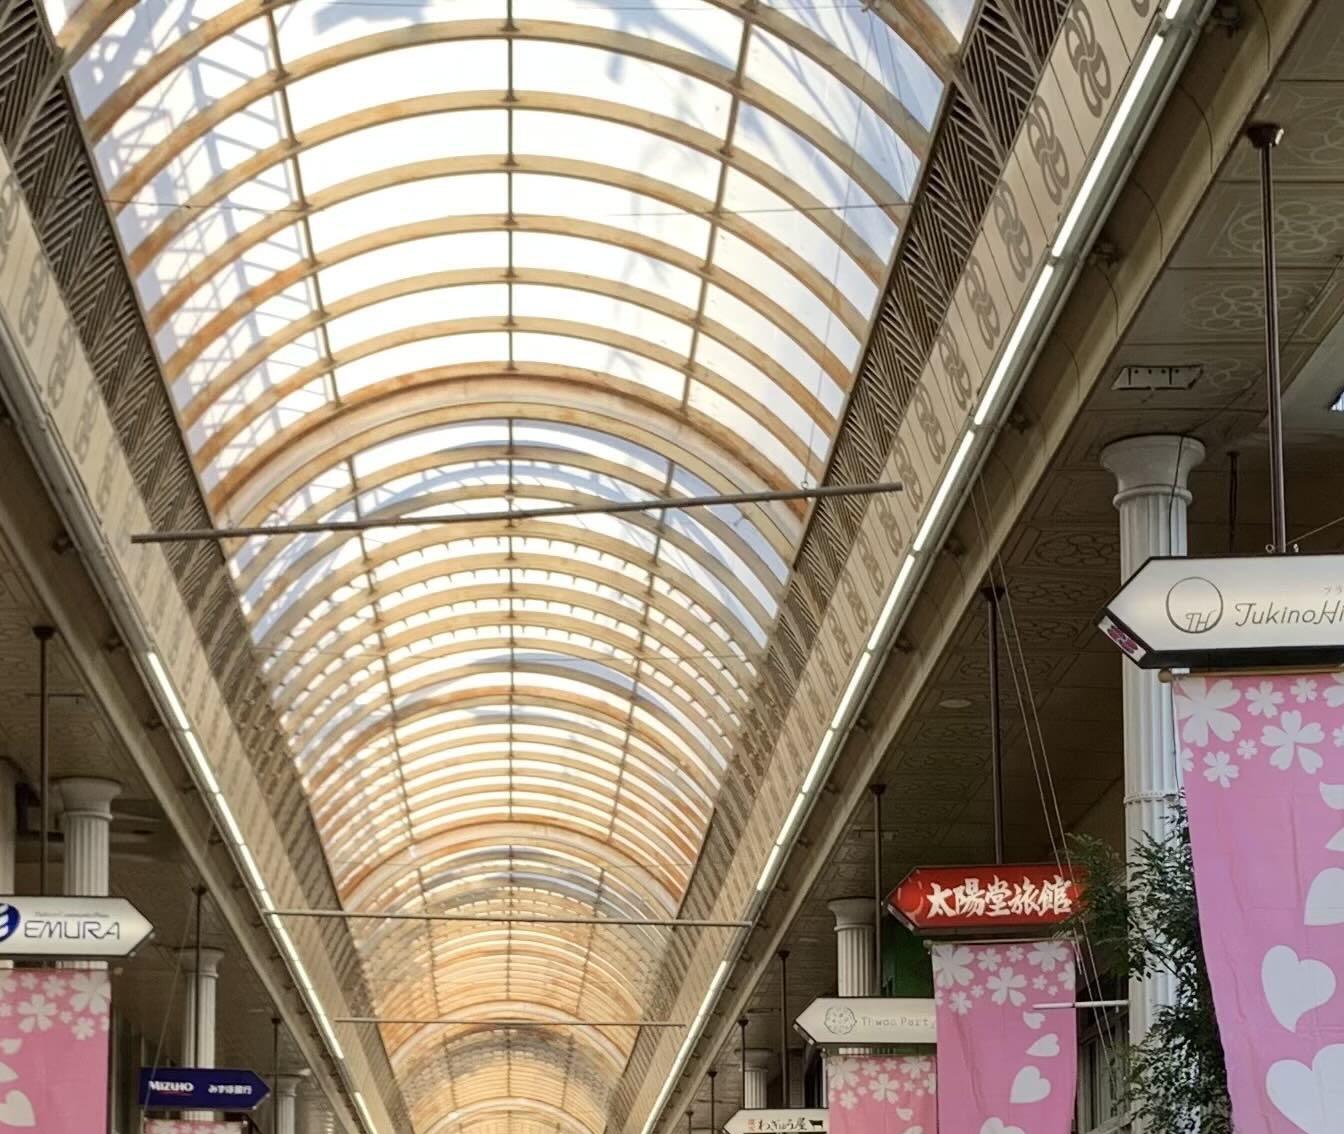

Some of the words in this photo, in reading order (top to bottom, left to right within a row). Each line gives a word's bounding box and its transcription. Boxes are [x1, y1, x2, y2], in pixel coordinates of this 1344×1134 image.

[927, 874, 1073, 919] 太陽堂旅館
[24, 920, 120, 940] EMURA
[149, 1080, 194, 1092] MIZUHO
[208, 1084, 253, 1095] みずほ銀行
